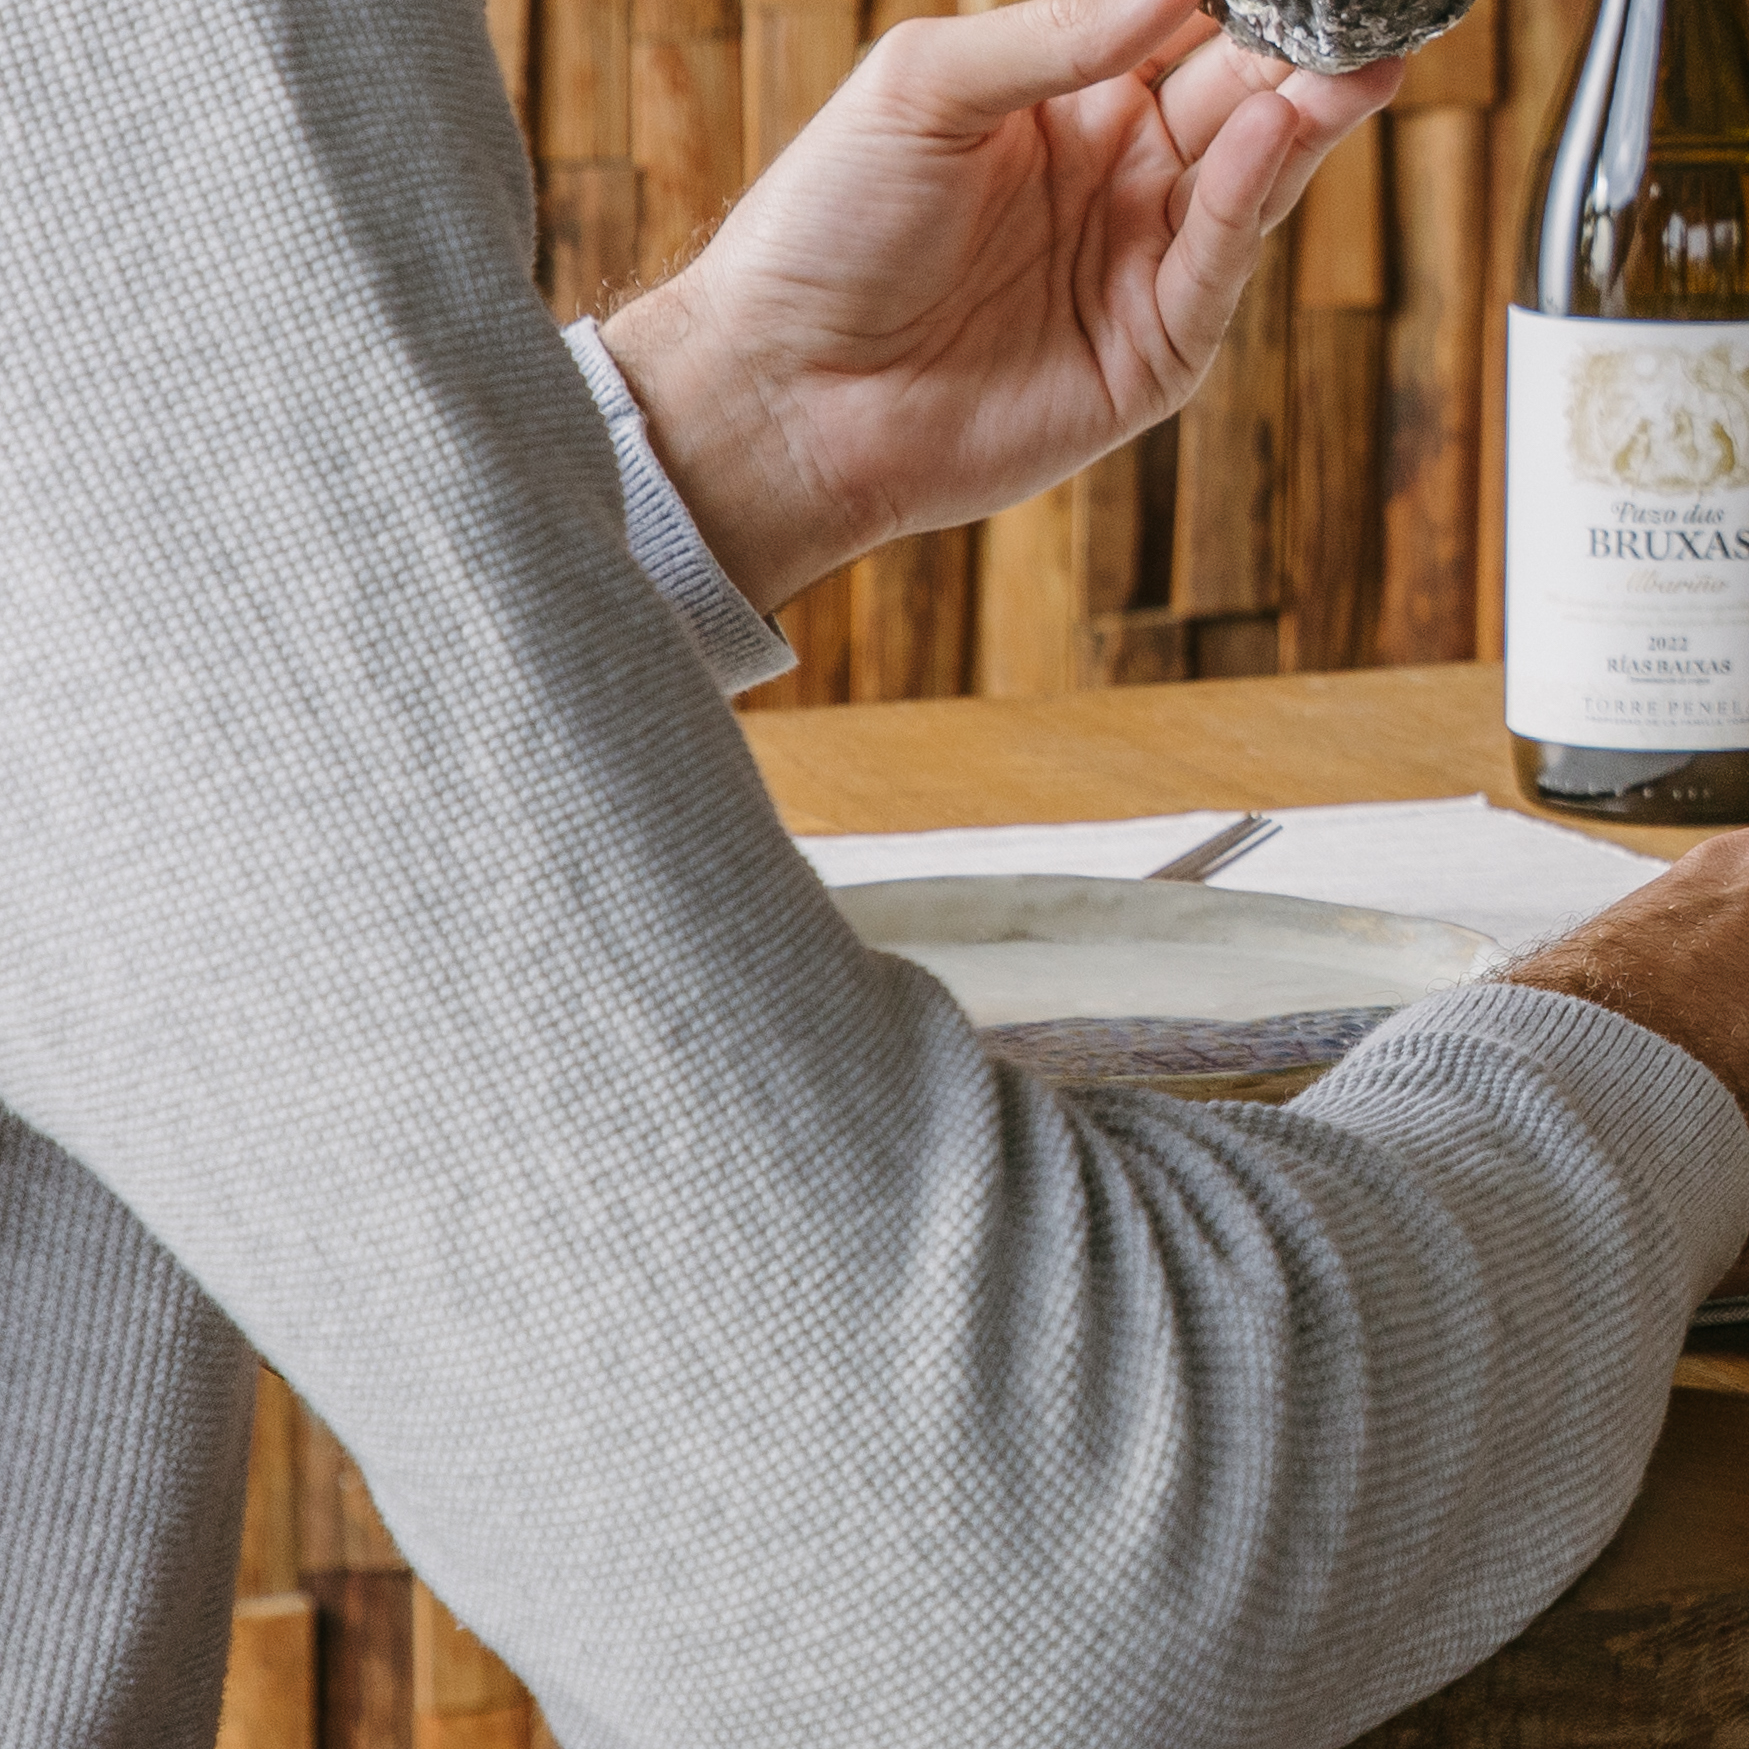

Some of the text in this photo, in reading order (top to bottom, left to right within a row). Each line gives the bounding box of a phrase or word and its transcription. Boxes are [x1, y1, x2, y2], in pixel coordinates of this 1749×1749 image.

[1683, 504, 1725, 524] das
[1648, 636, 1688, 652] 2022
[1656, 658, 1732, 676] BAIXAS
[1582, 697, 1657, 715] TORRE
